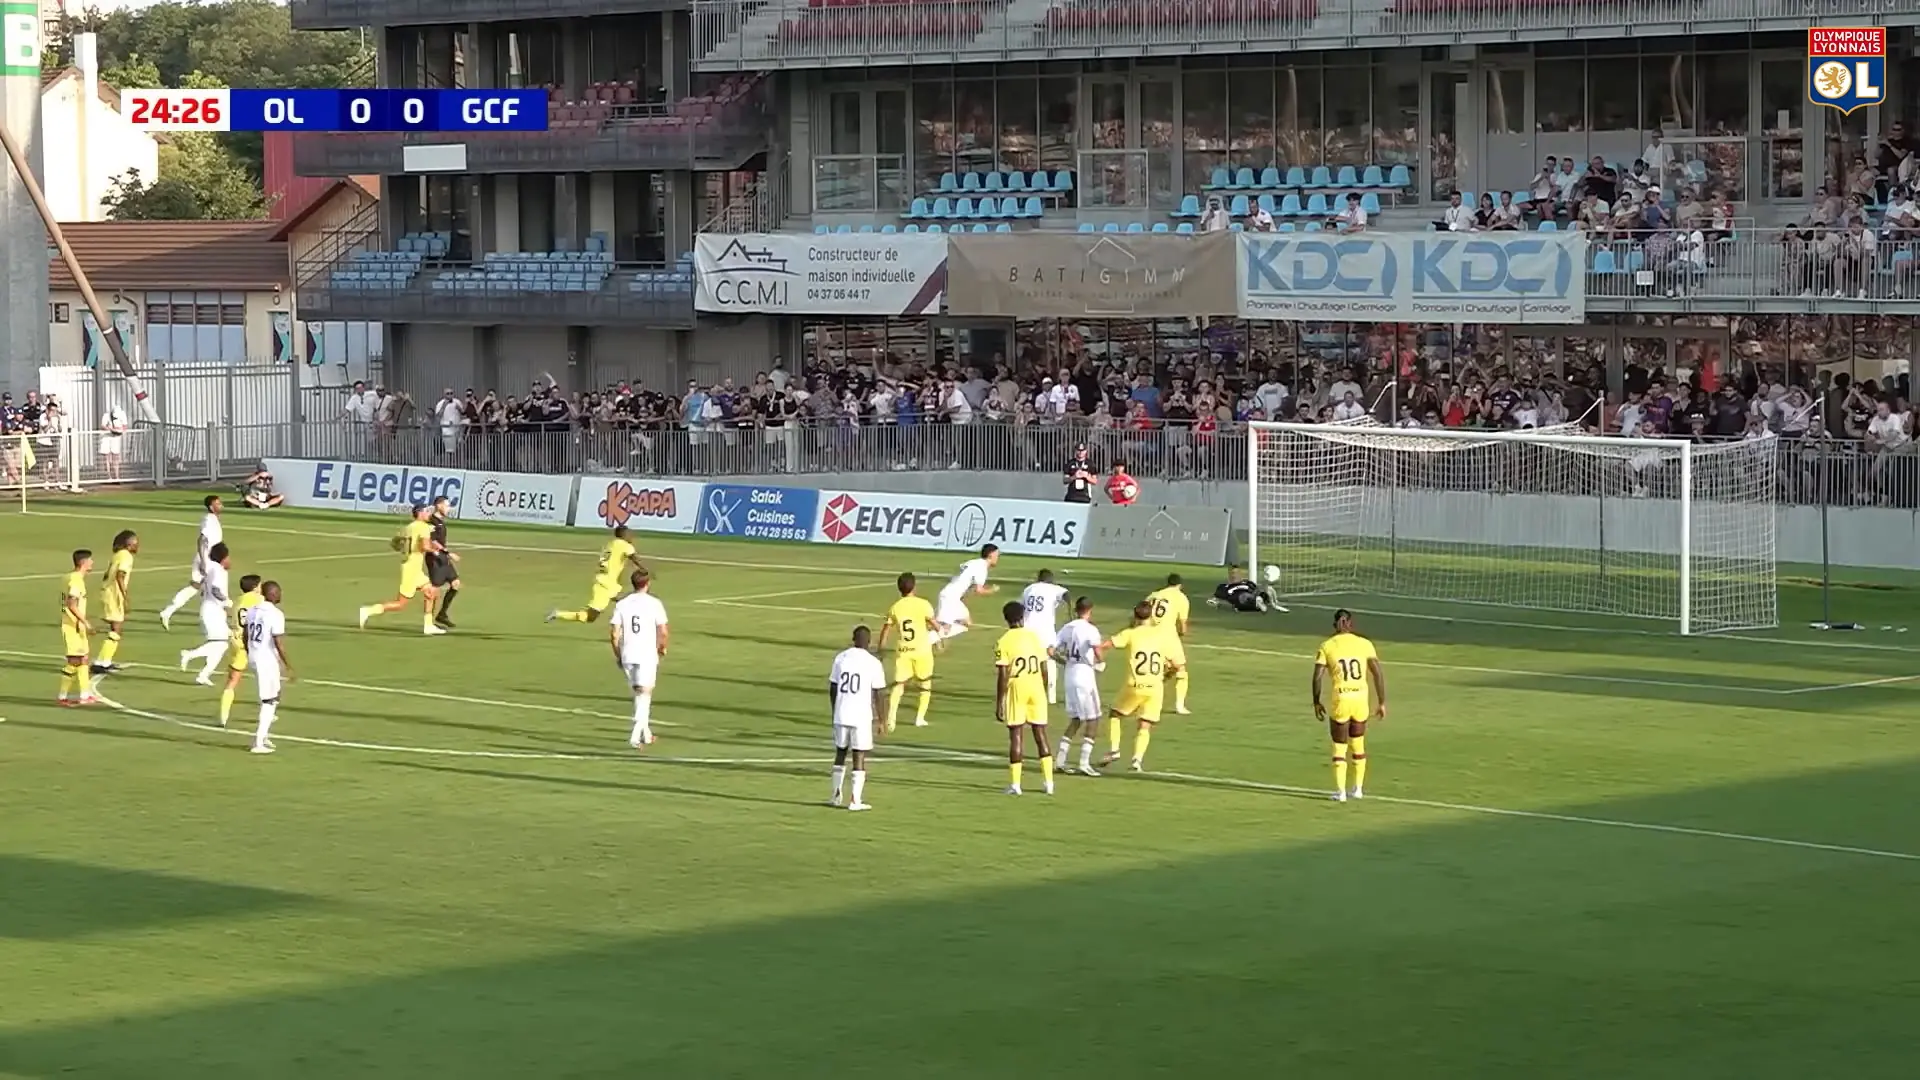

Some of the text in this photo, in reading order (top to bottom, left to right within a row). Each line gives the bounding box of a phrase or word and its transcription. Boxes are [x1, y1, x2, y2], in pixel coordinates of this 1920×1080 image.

[808, 247, 899, 261] Constructeur de
[1247, 239, 1374, 292] KDC
[808, 268, 916, 283] maison individuelle
[1412, 239, 1547, 293] KDC
[807, 289, 819, 299] 04
[821, 289, 832, 299] 37
[485, 490, 556, 511] CAPEXEL
[747, 508, 796, 525] Cuisines
[855, 506, 945, 537] ELYFEC
[988, 517, 1077, 546] ATLAS
[1027, 595, 1045, 612] 98
[631, 615, 641, 634] 6
[902, 619, 915, 642] 5
[1009, 656, 1039, 679] 20
[1135, 651, 1161, 676] 26
[1338, 658, 1362, 681] 10
[840, 671, 861, 694] 20
